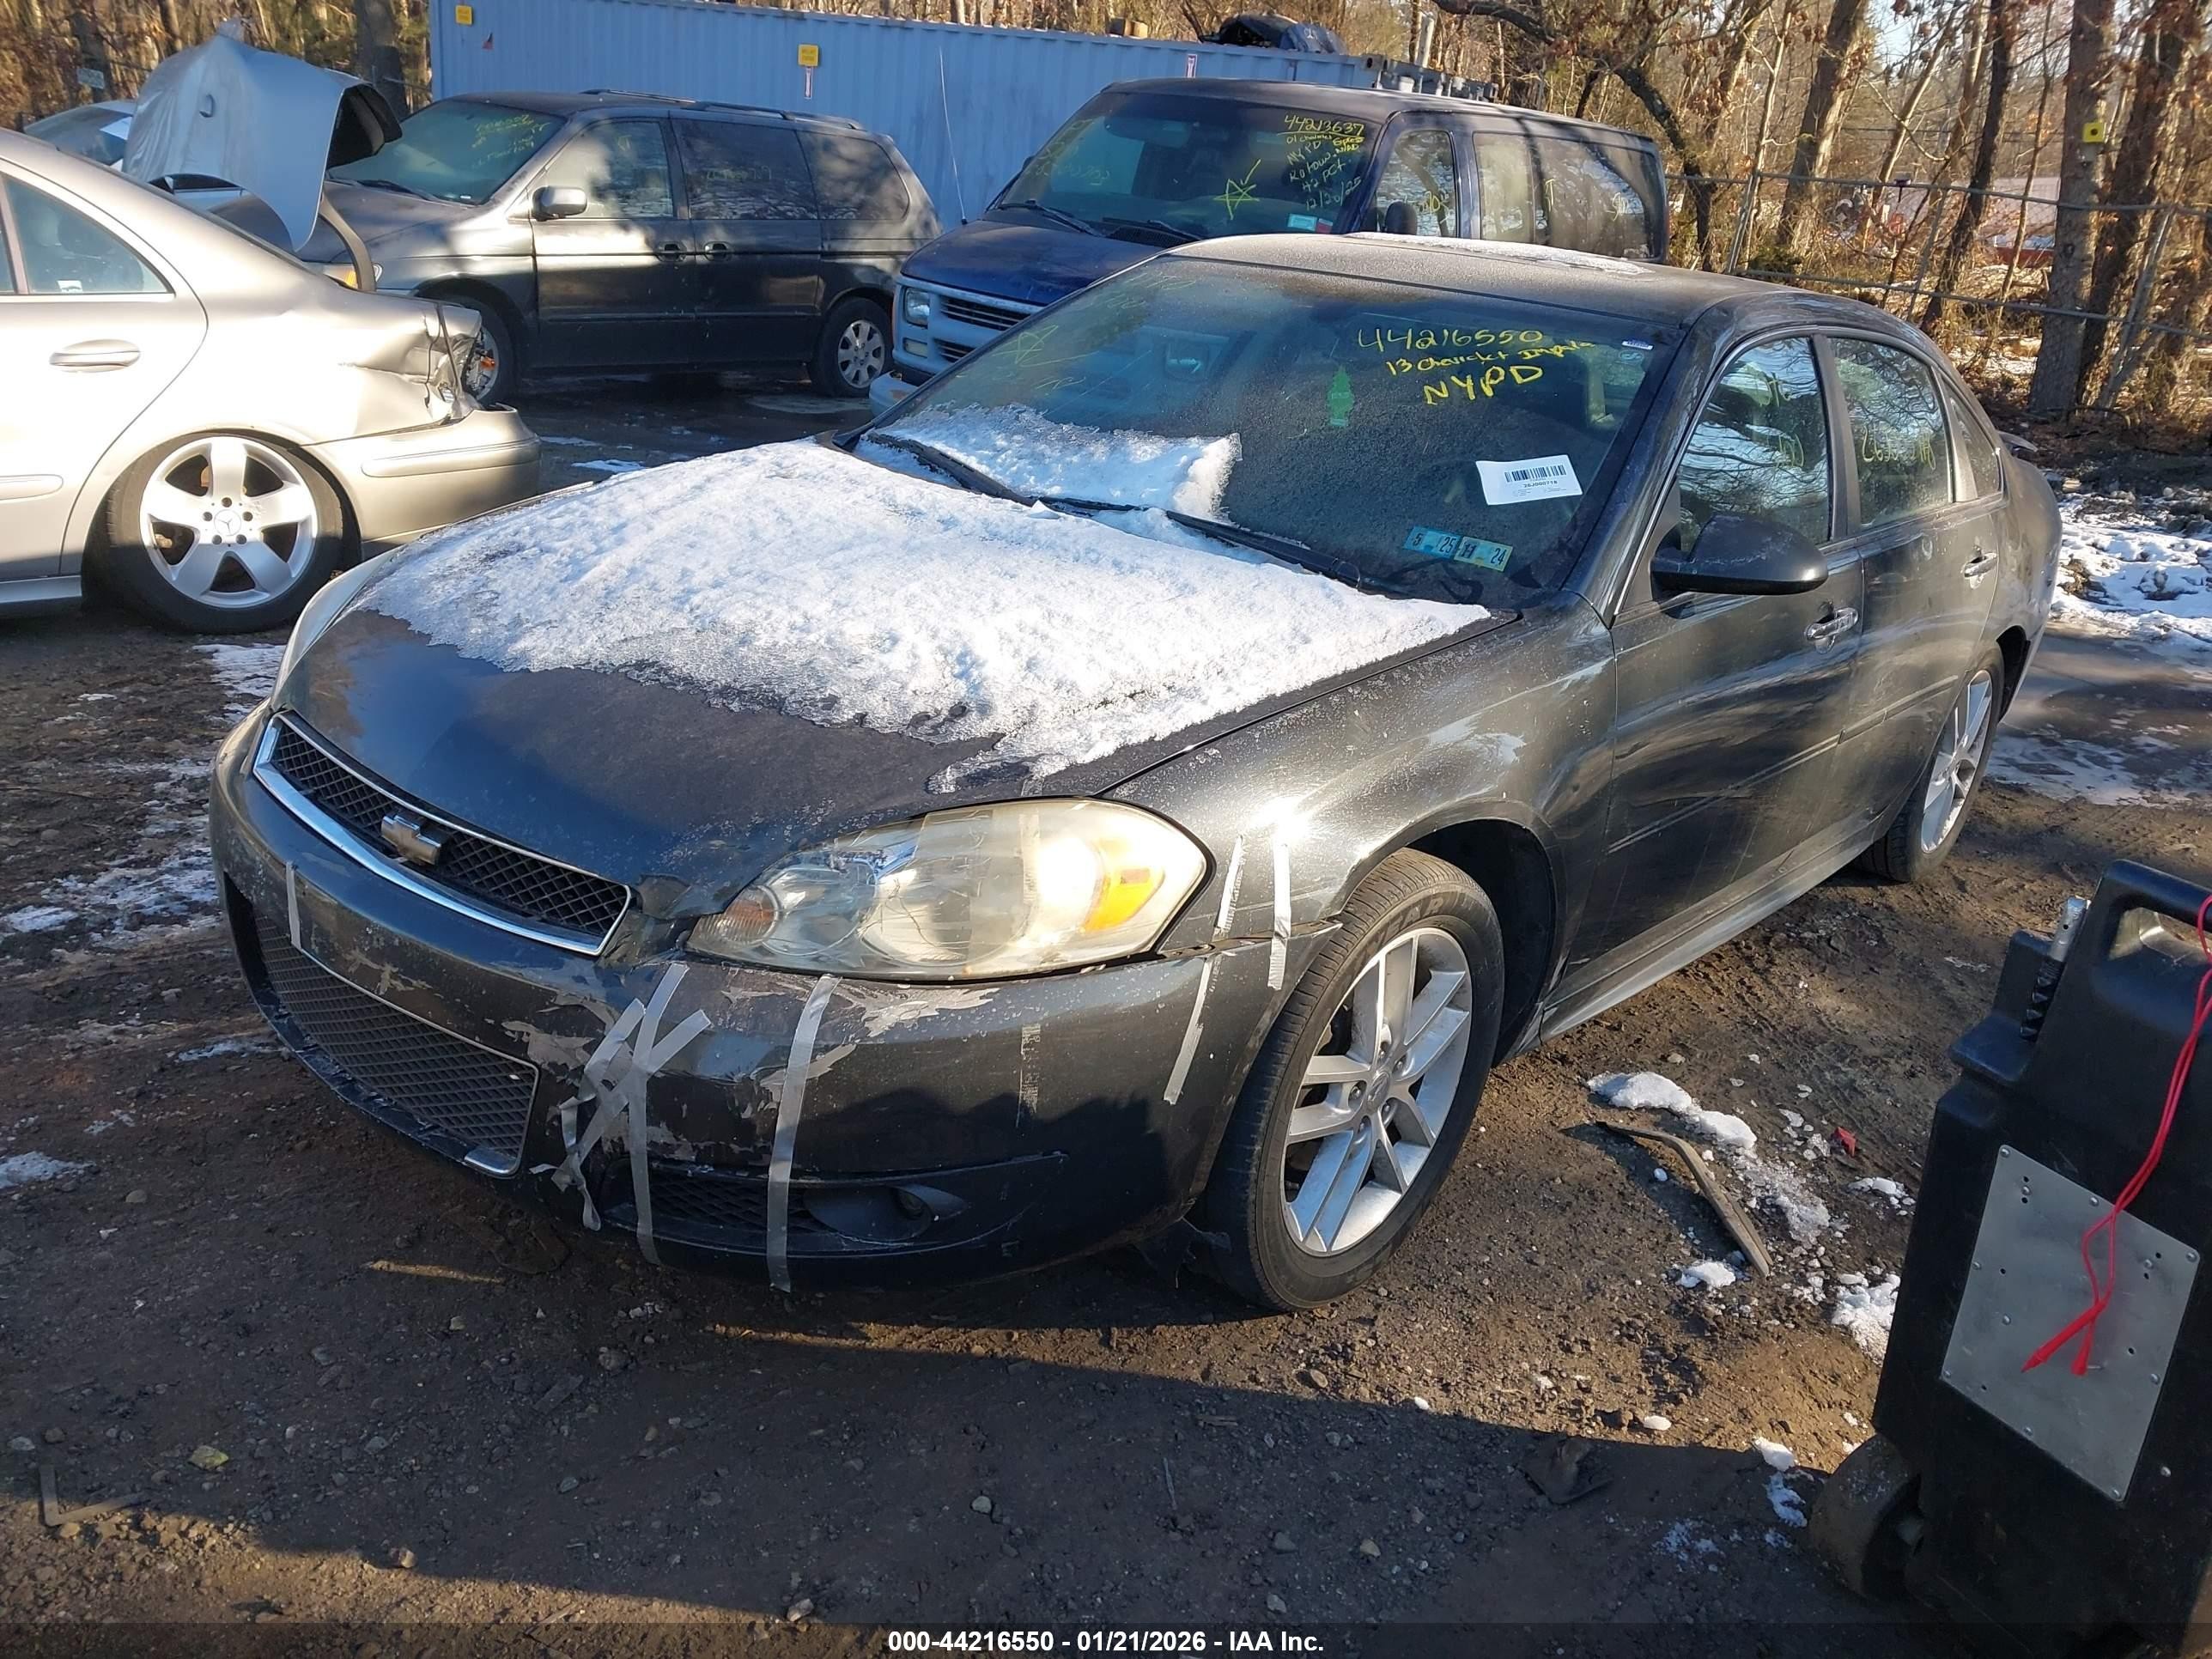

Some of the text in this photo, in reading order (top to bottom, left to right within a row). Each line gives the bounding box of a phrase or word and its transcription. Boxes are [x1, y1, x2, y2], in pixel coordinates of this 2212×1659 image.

[1284, 115, 1364, 136] 44213637
[1358, 329, 1544, 353] 44216550
[1386, 358, 1413, 376] 13
[1423, 365, 1544, 405] NYPD
[1439, 536, 1457, 553] 25
[1490, 547, 1507, 565] 24
